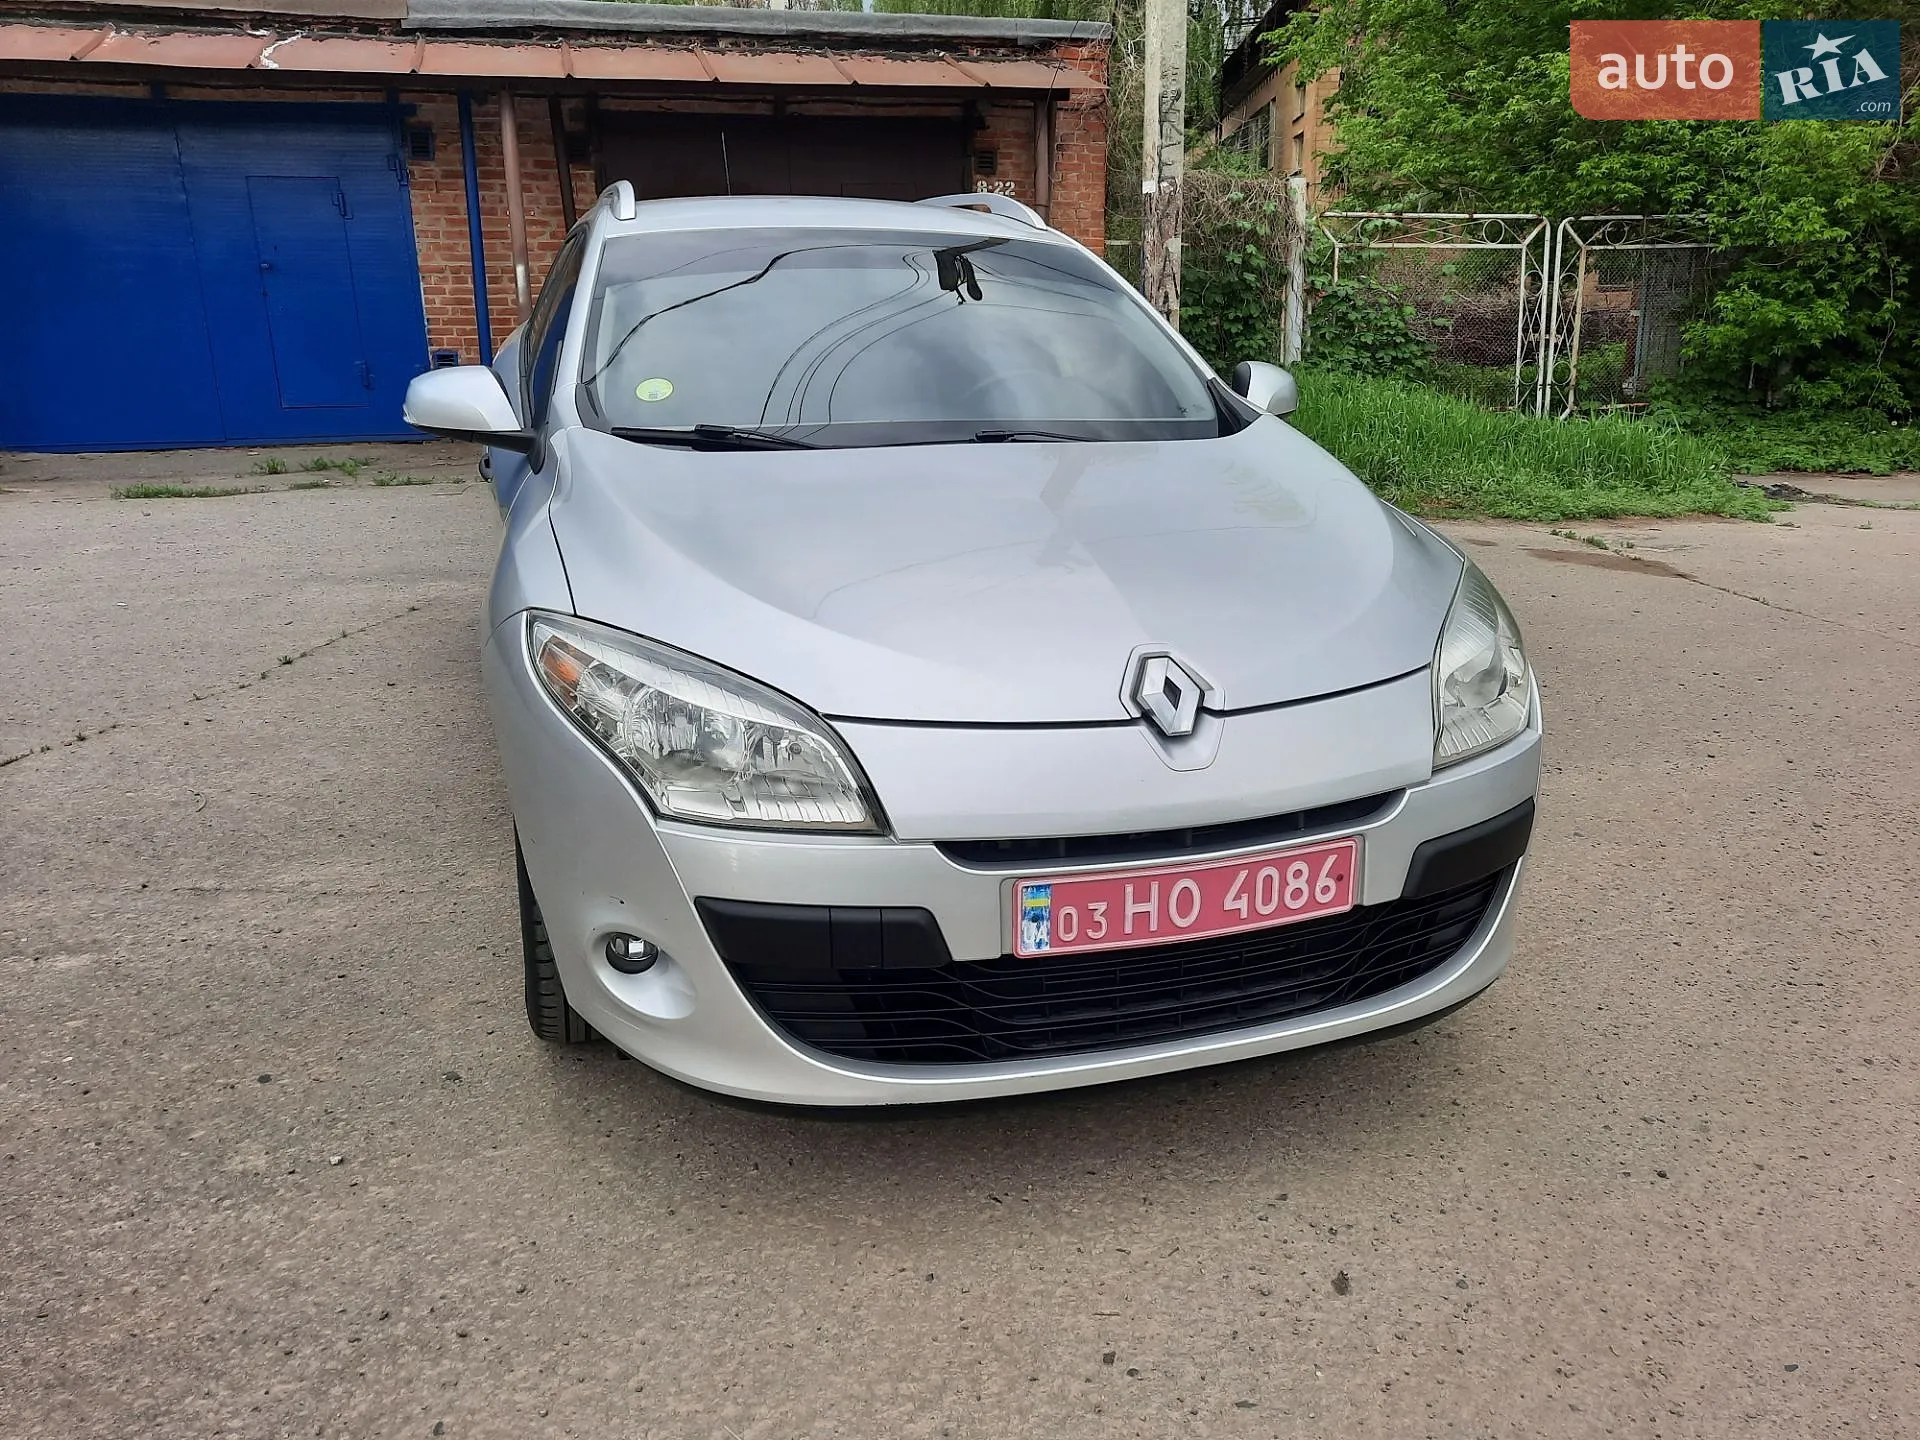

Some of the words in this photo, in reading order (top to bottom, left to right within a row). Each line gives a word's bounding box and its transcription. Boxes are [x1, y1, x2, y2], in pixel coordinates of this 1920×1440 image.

[1057, 901, 1108, 942] 03
[1123, 878, 1201, 934] HO
[1223, 854, 1339, 920] 4086
